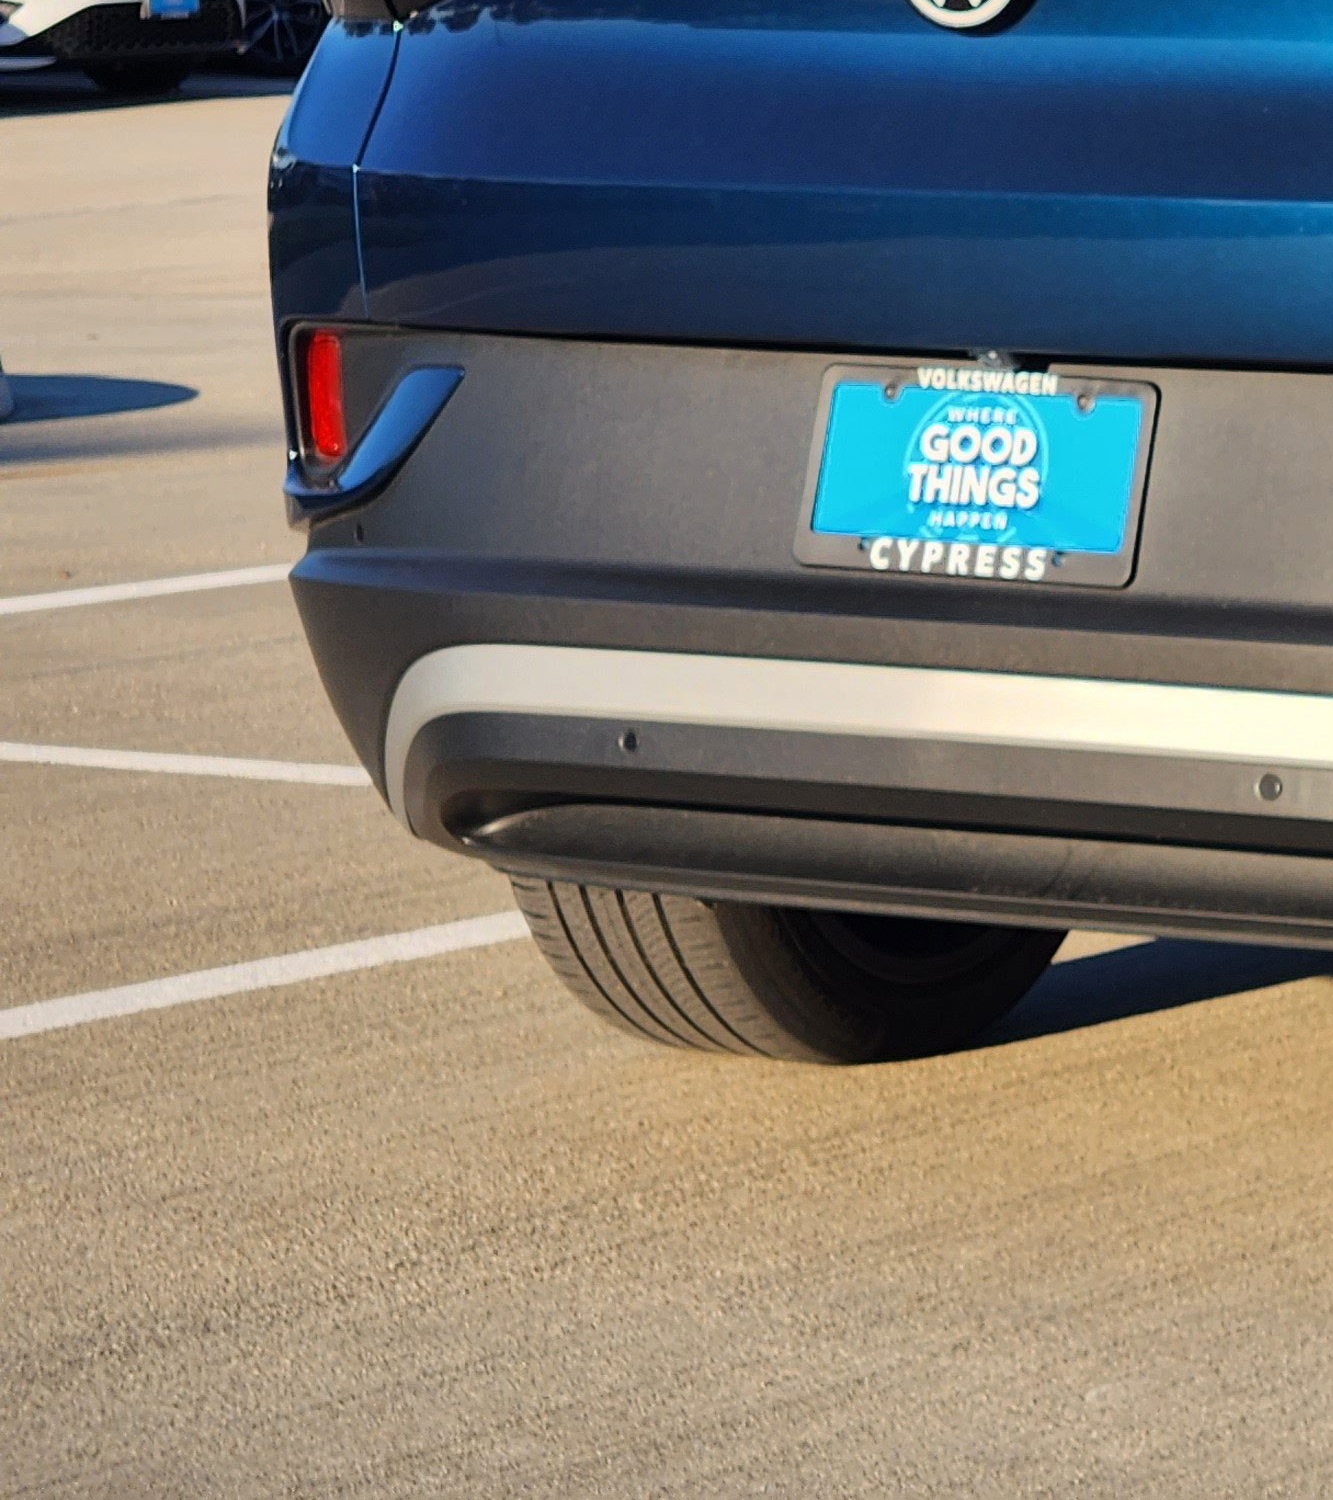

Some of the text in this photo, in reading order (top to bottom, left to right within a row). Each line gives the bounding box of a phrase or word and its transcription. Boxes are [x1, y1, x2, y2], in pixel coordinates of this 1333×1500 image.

[917, 368, 1058, 396] VOLKSWAGEN
[948, 406, 1017, 425] WHERE
[920, 424, 1037, 466] GOOD
[908, 463, 1040, 510] THINGS
[929, 511, 1008, 531] HAPPEN
[869, 537, 1047, 581] CYPRESS
